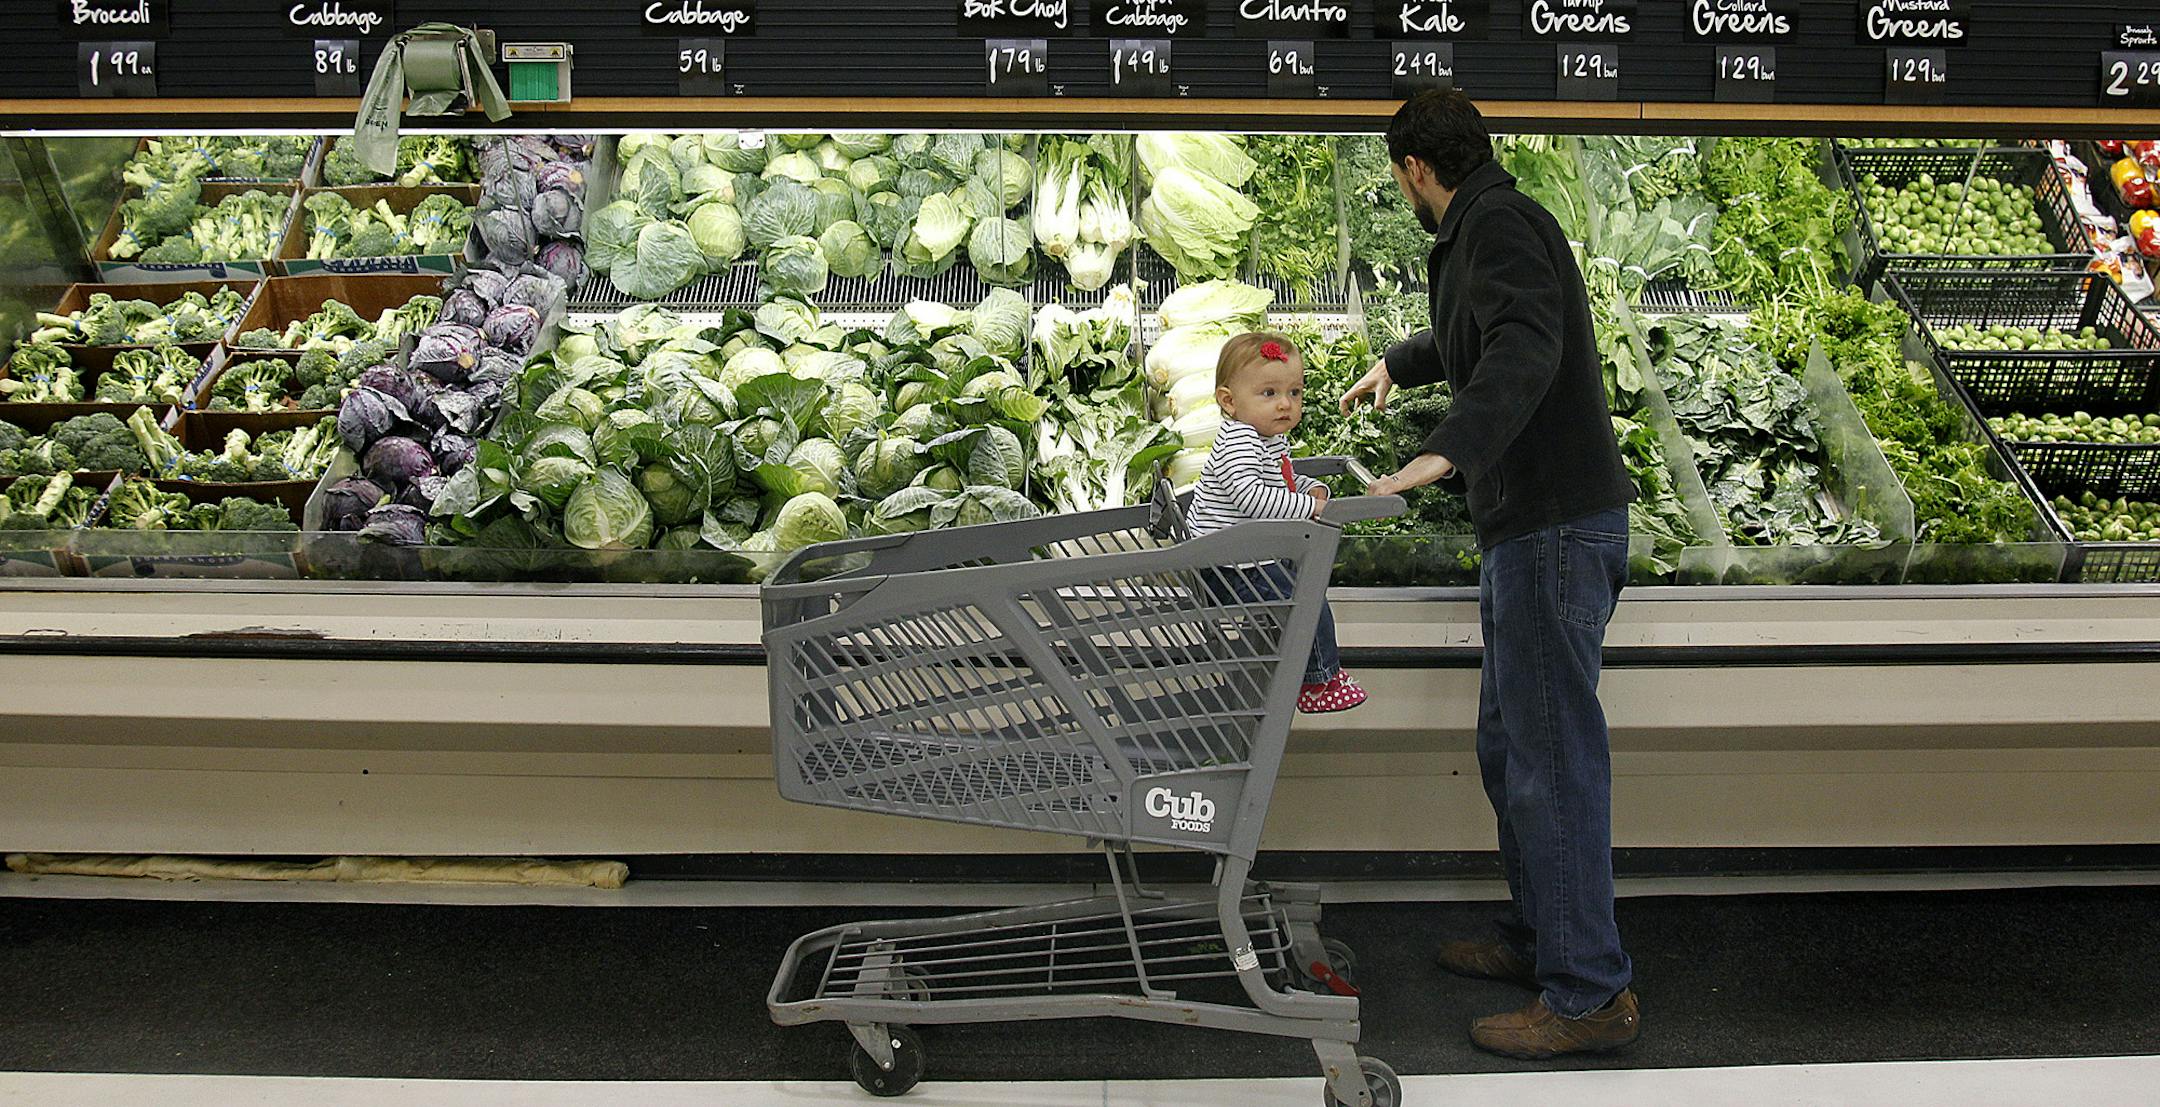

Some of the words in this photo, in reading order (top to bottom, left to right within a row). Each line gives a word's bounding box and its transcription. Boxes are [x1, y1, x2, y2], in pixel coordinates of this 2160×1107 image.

[70, 0, 150, 24] Broccoli
[289, 2, 383, 34] Cabbage
[645, 0, 750, 33] Cabbage
[963, 0, 1006, 19] Bok
[1009, 0, 1068, 29] Choy
[1239, 0, 1347, 21] Cilantro
[1398, 2, 1466, 33] Kale
[1531, 0, 1631, 34] Greens
[1692, 0, 1791, 36] Greens
[1716, 0, 1767, 12] Collard
[1882, 0, 1950, 12] Mustard
[1105, 4, 1189, 34] Cabbage
[1866, 5, 1964, 40] Greens
[2120, 32, 2158, 48] Sprouts
[314, 49, 343, 74] 89
[679, 49, 707, 73] 59
[1269, 50, 1298, 75] 69
[1394, 52, 1437, 76] 249
[1563, 53, 1602, 78] 129
[1721, 56, 1760, 80] 129
[1892, 58, 1930, 82] 129
[1145, 786, 1216, 822] Cub
[1170, 818, 1211, 833] FOODS
